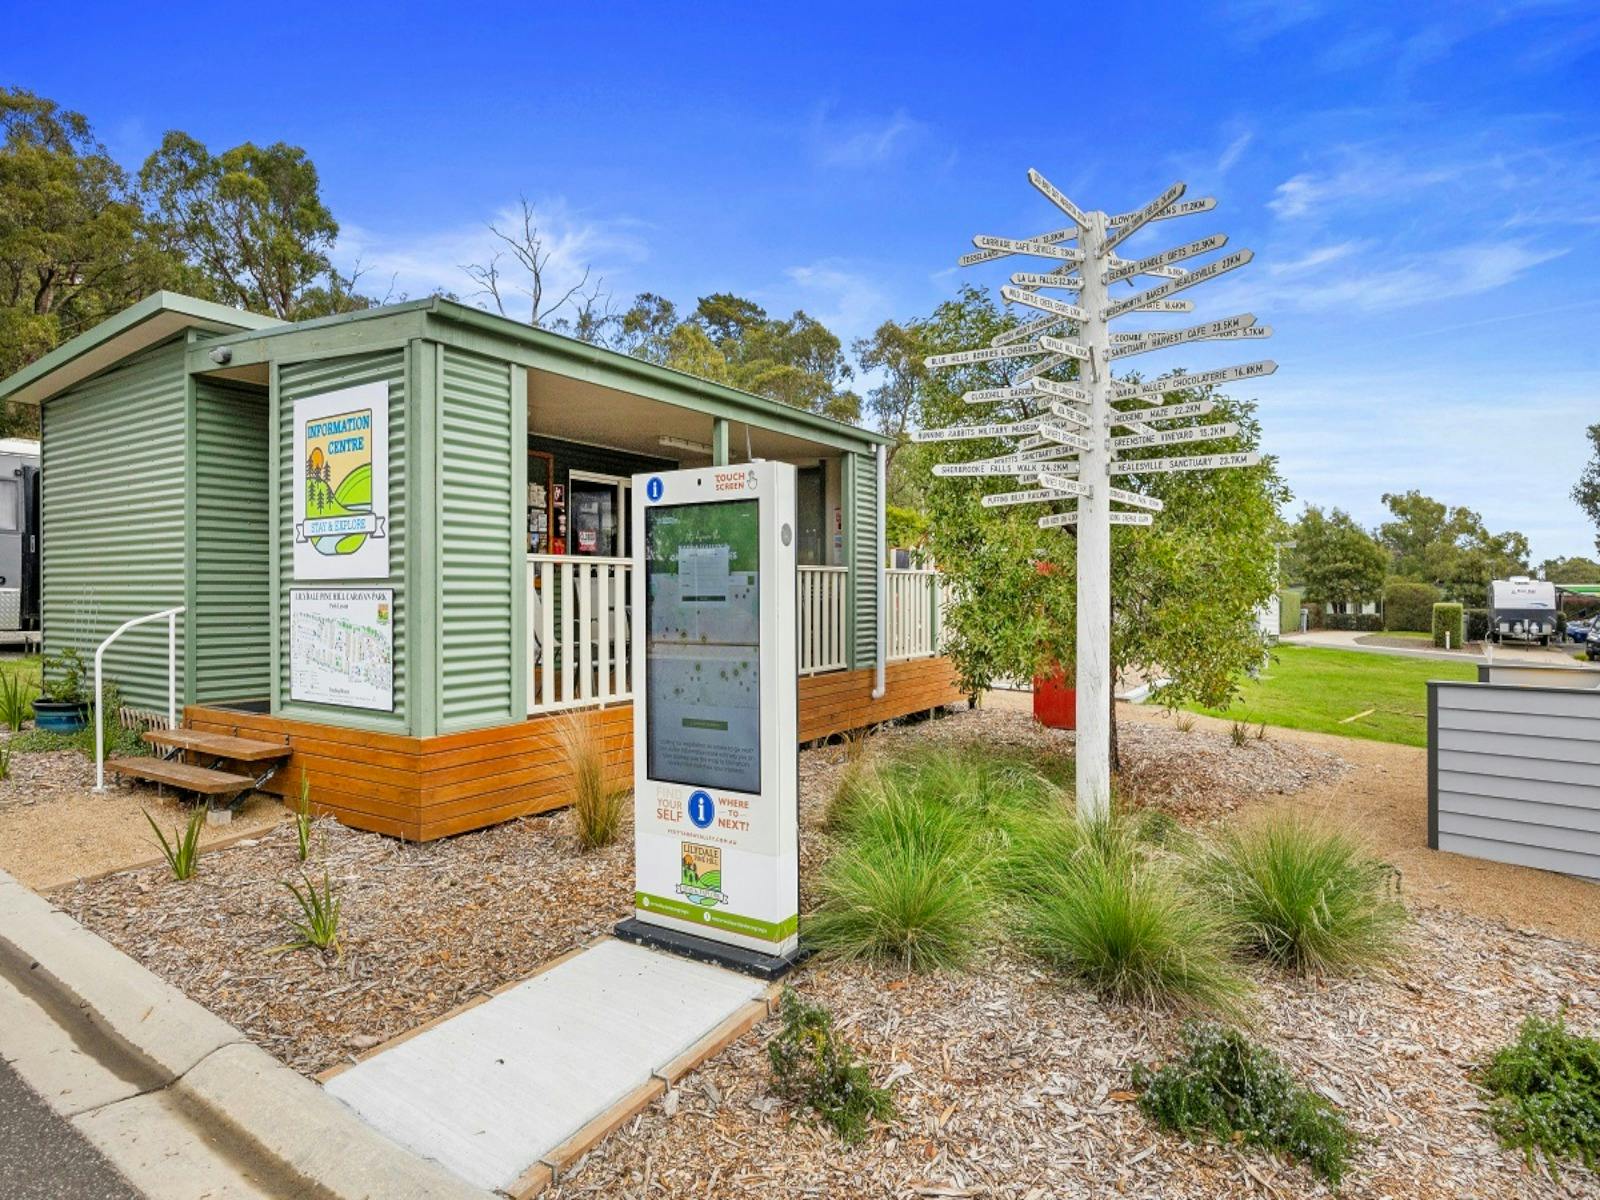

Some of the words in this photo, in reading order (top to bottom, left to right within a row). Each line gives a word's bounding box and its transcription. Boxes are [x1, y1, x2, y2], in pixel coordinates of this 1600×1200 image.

[1173, 371, 1227, 388] CHOCOLATERIE
[307, 415, 370, 439] INFORMATION
[328, 436, 365, 455] CENTRE
[1169, 457, 1213, 469] SANCTUARY
[714, 472, 745, 483] TOUCH
[715, 482, 745, 492] SCREEN
[311, 521, 327, 534] STAY
[327, 522, 333, 532] &
[334, 518, 366, 531] EXPLORE
[656, 785, 682, 800] FIND
[656, 799, 682, 810] YOUR
[719, 797, 749, 809] WHERE
[656, 808, 683, 823] SELF
[728, 809, 739, 818] TO
[718, 818, 750, 832] NEXT!
[683, 845, 719, 859] LILYDALE
